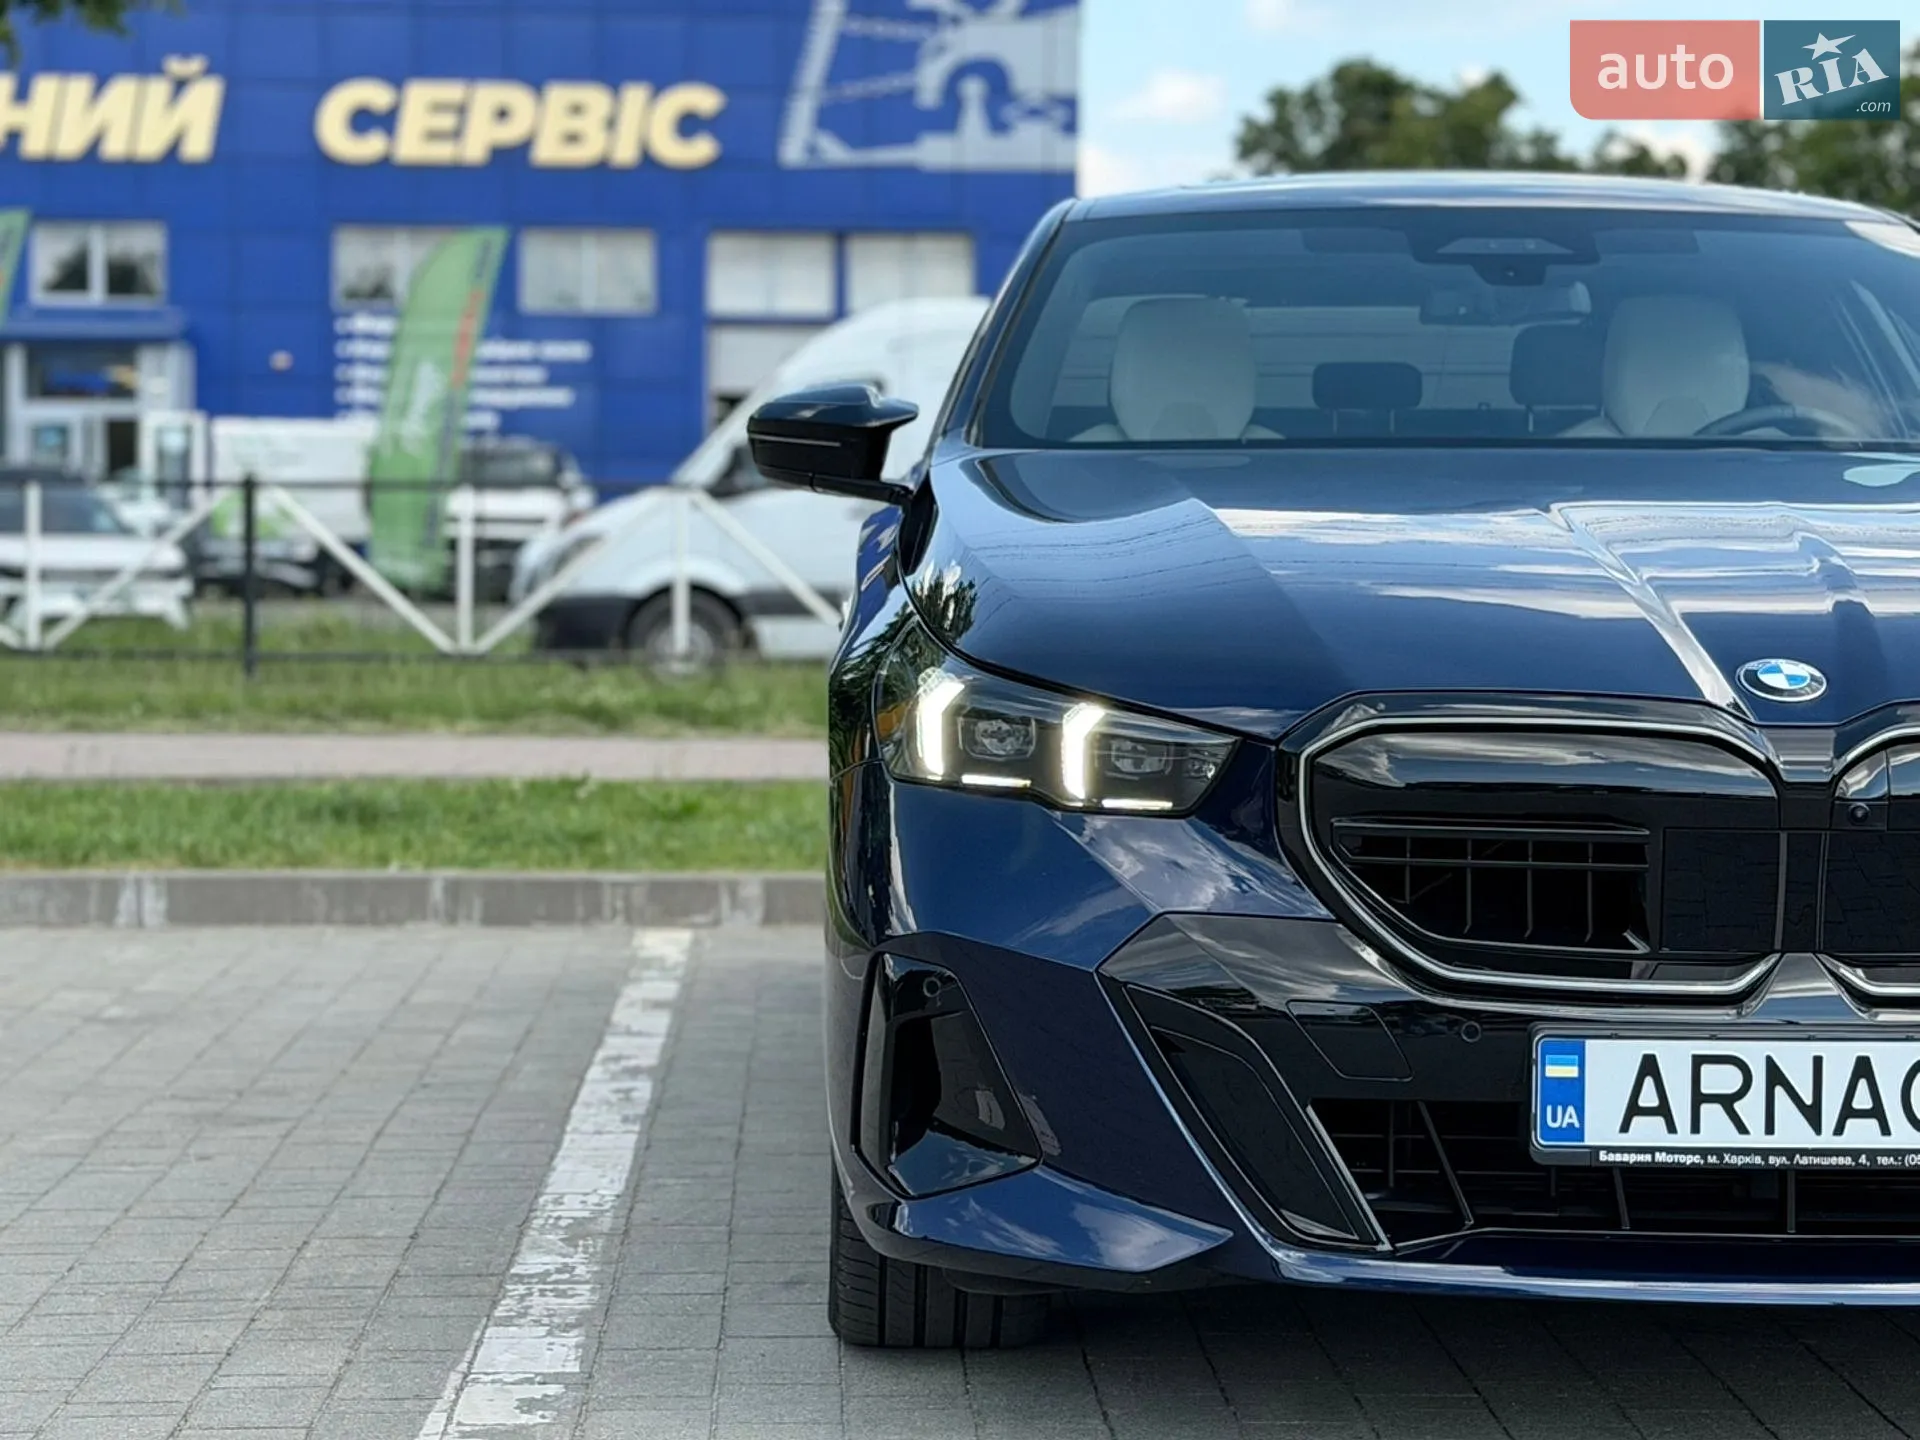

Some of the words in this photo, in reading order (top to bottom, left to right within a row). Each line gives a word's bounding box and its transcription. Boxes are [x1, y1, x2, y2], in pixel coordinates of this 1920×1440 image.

[314, 76, 726, 170] СЕРВІС
[1545, 1105, 1580, 1129] UA
[1654, 1152, 1704, 1166] Моторс,
[1707, 1154, 1720, 1164] м.
[1768, 1155, 1790, 1167] вул.
[1858, 1154, 1871, 1166] 4,
[1876, 1155, 1902, 1166] тел.:
